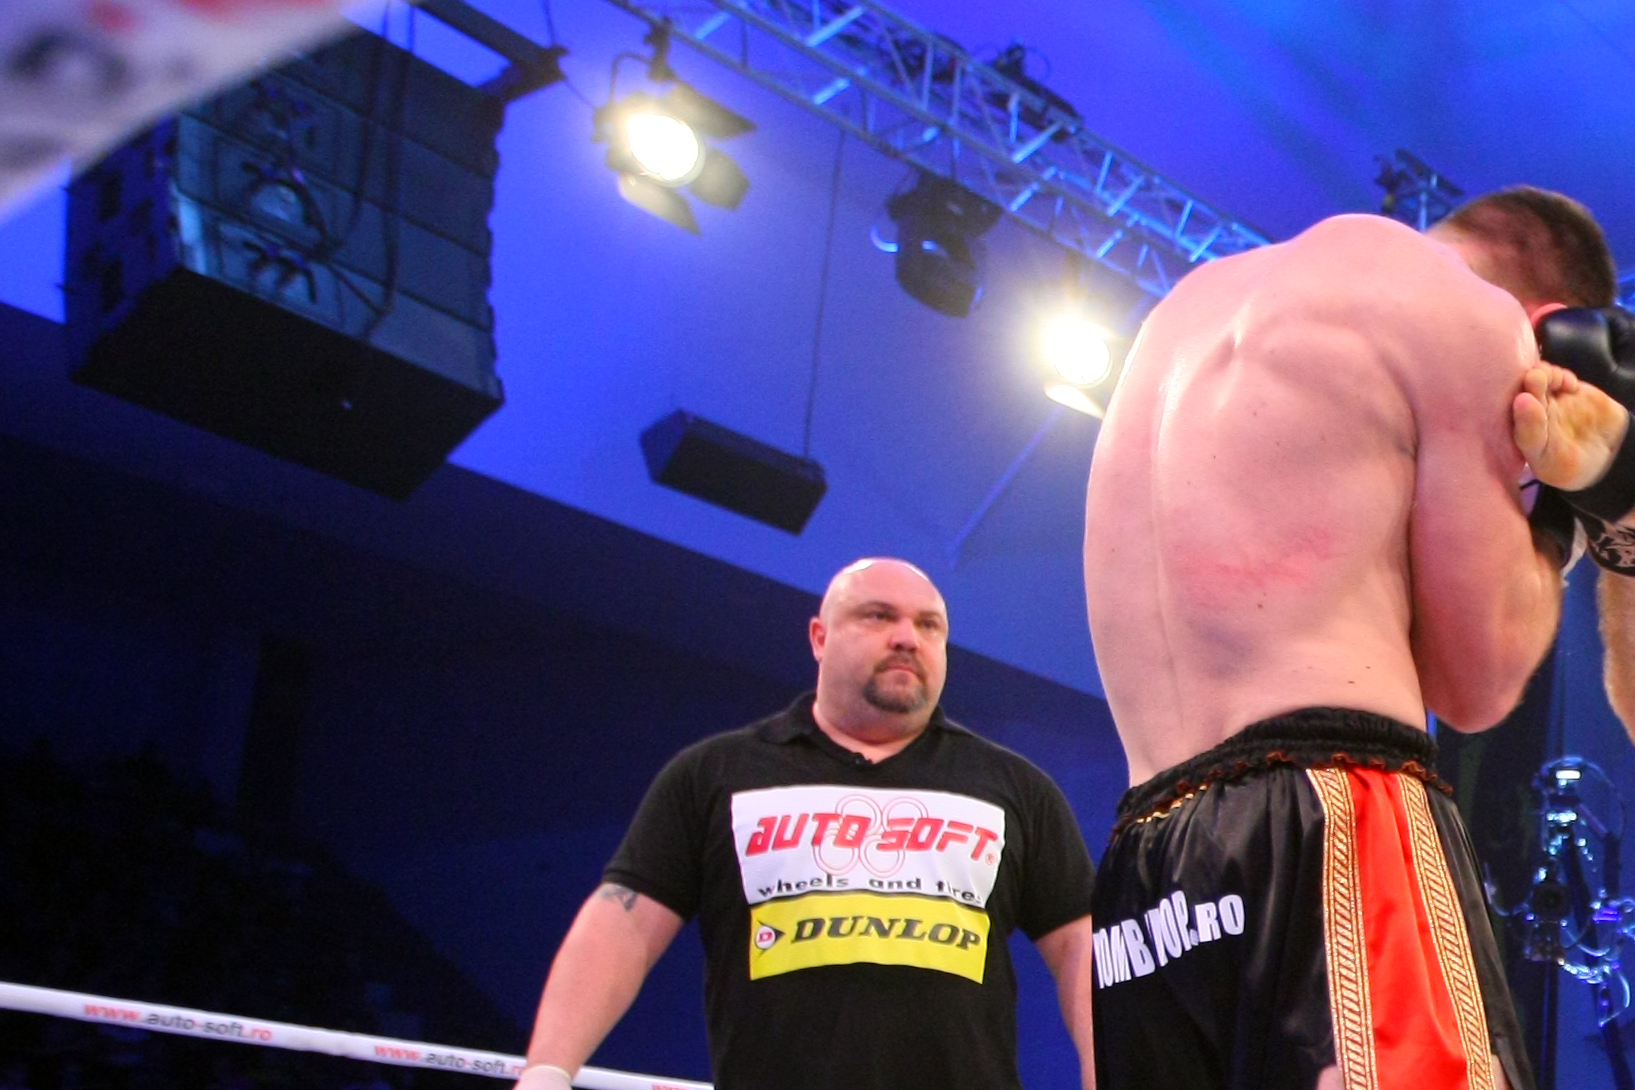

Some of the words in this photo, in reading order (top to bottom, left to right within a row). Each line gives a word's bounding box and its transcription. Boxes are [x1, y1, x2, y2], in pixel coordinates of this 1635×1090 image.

[757, 873, 850, 897] wheels
[869, 877, 922, 891] and
[791, 915, 981, 950] DUNLOP
[85, 1004, 273, 1041] www.auto-soft.ro
[374, 1045, 521, 1074] www.auto-soft.r
